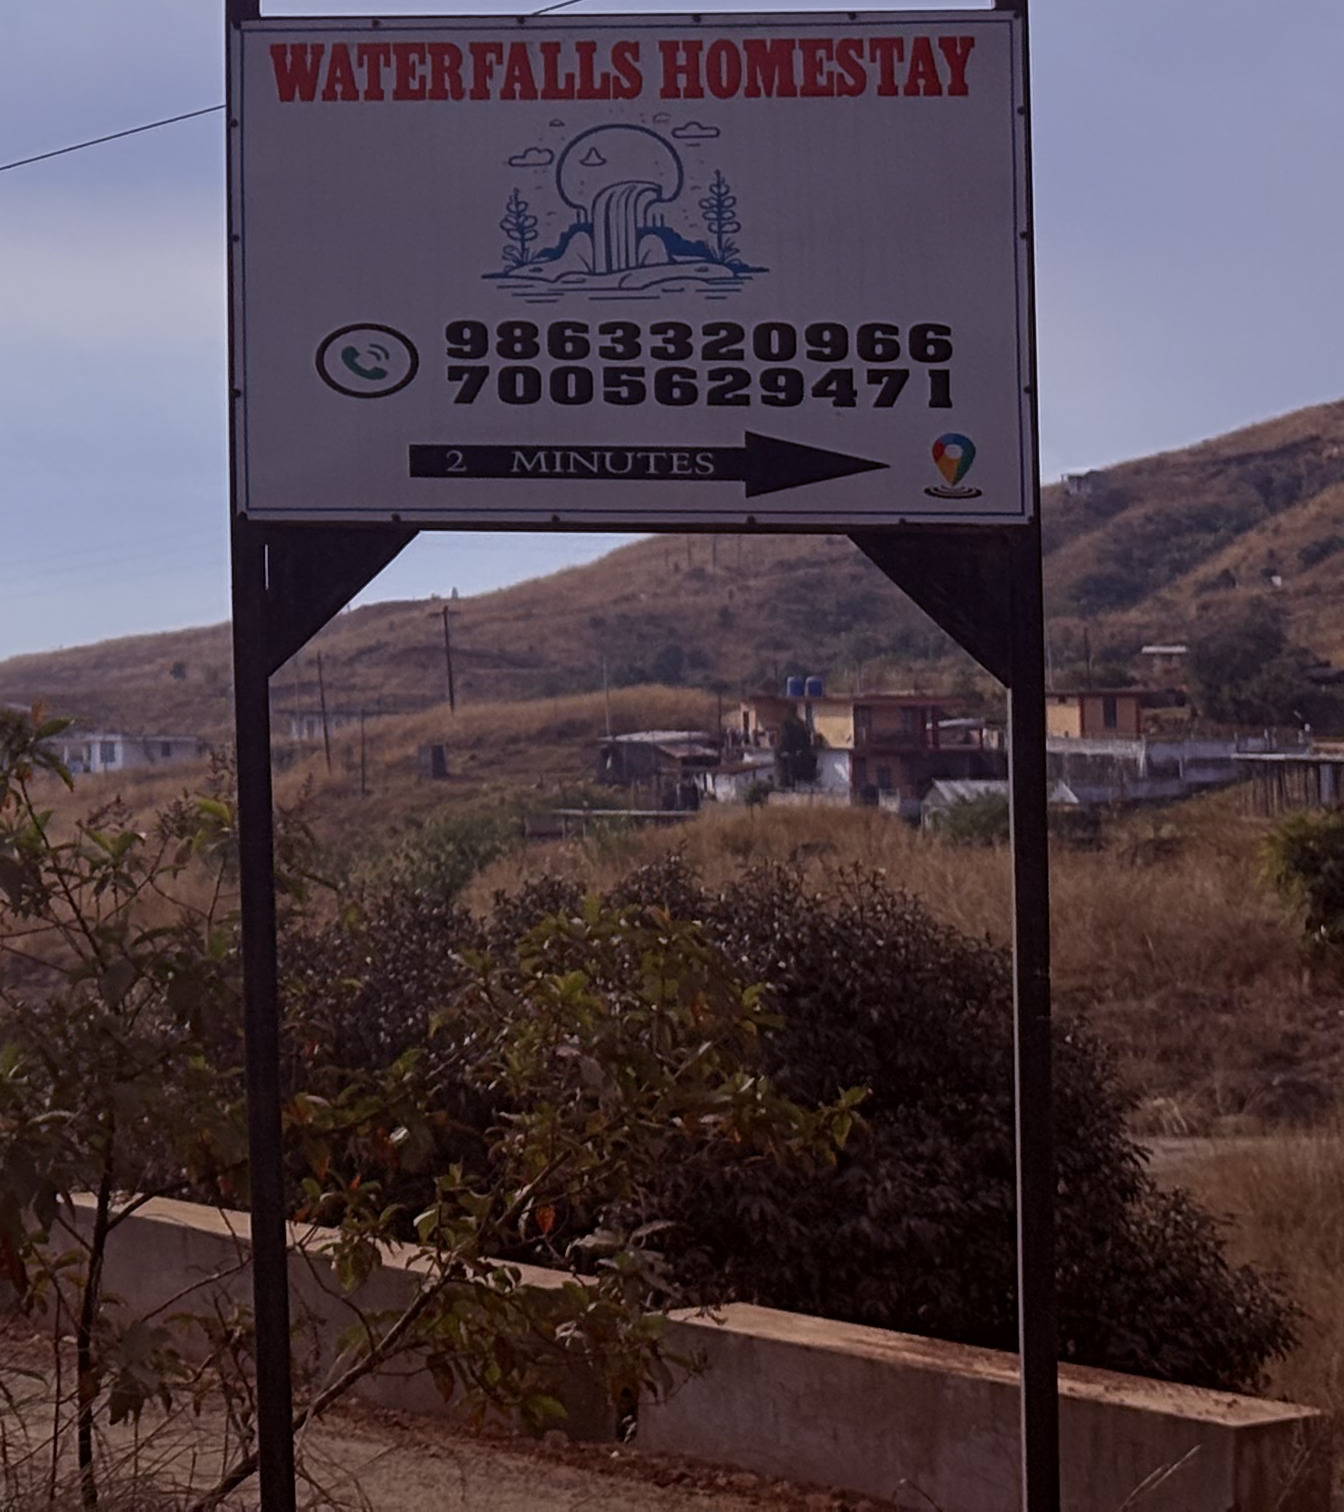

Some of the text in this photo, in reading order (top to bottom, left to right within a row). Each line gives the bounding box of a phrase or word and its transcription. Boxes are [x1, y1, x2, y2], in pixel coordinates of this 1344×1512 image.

[269, 35, 977, 104] WATERFALLS HOMESTAY
[445, 320, 954, 364] 9863320966
[445, 364, 954, 409] 7005629471
[445, 449, 716, 477] 2 MINUTES
